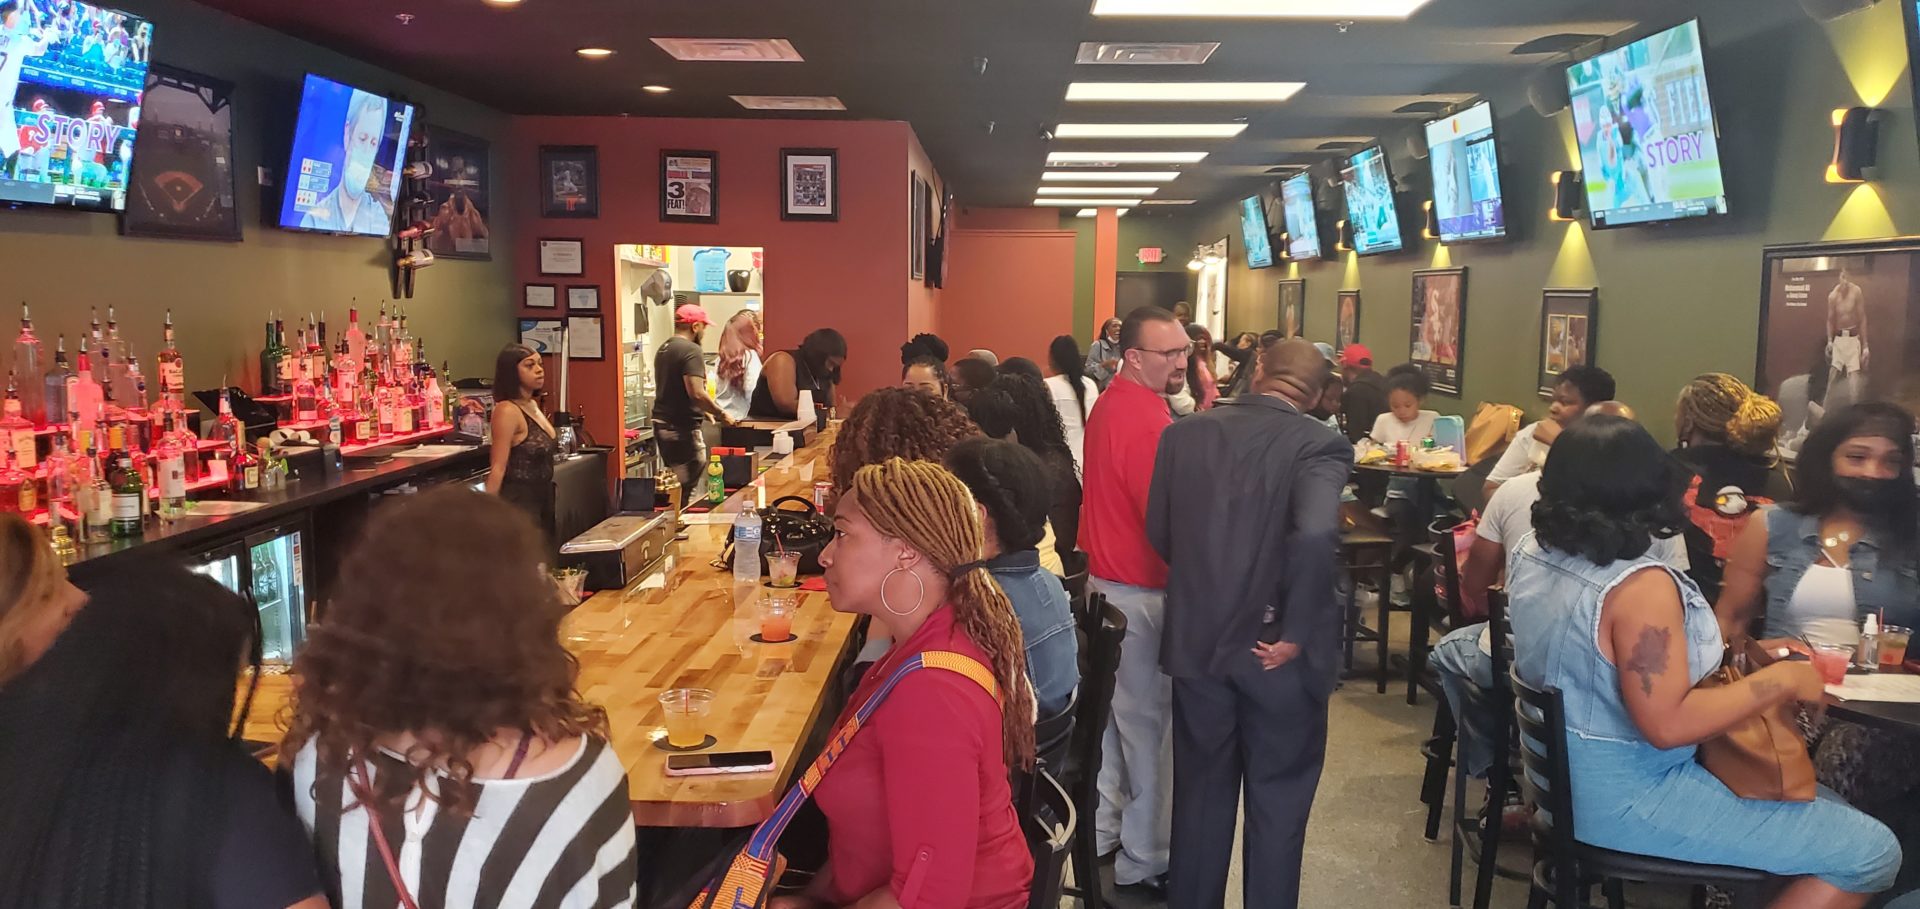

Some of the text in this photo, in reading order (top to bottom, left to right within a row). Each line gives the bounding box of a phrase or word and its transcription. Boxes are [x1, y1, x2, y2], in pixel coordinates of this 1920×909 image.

[34, 113, 121, 153] STORY
[1645, 131, 1703, 168] STORY
[668, 182, 685, 199] 3
[667, 199, 685, 210] FEAT!
